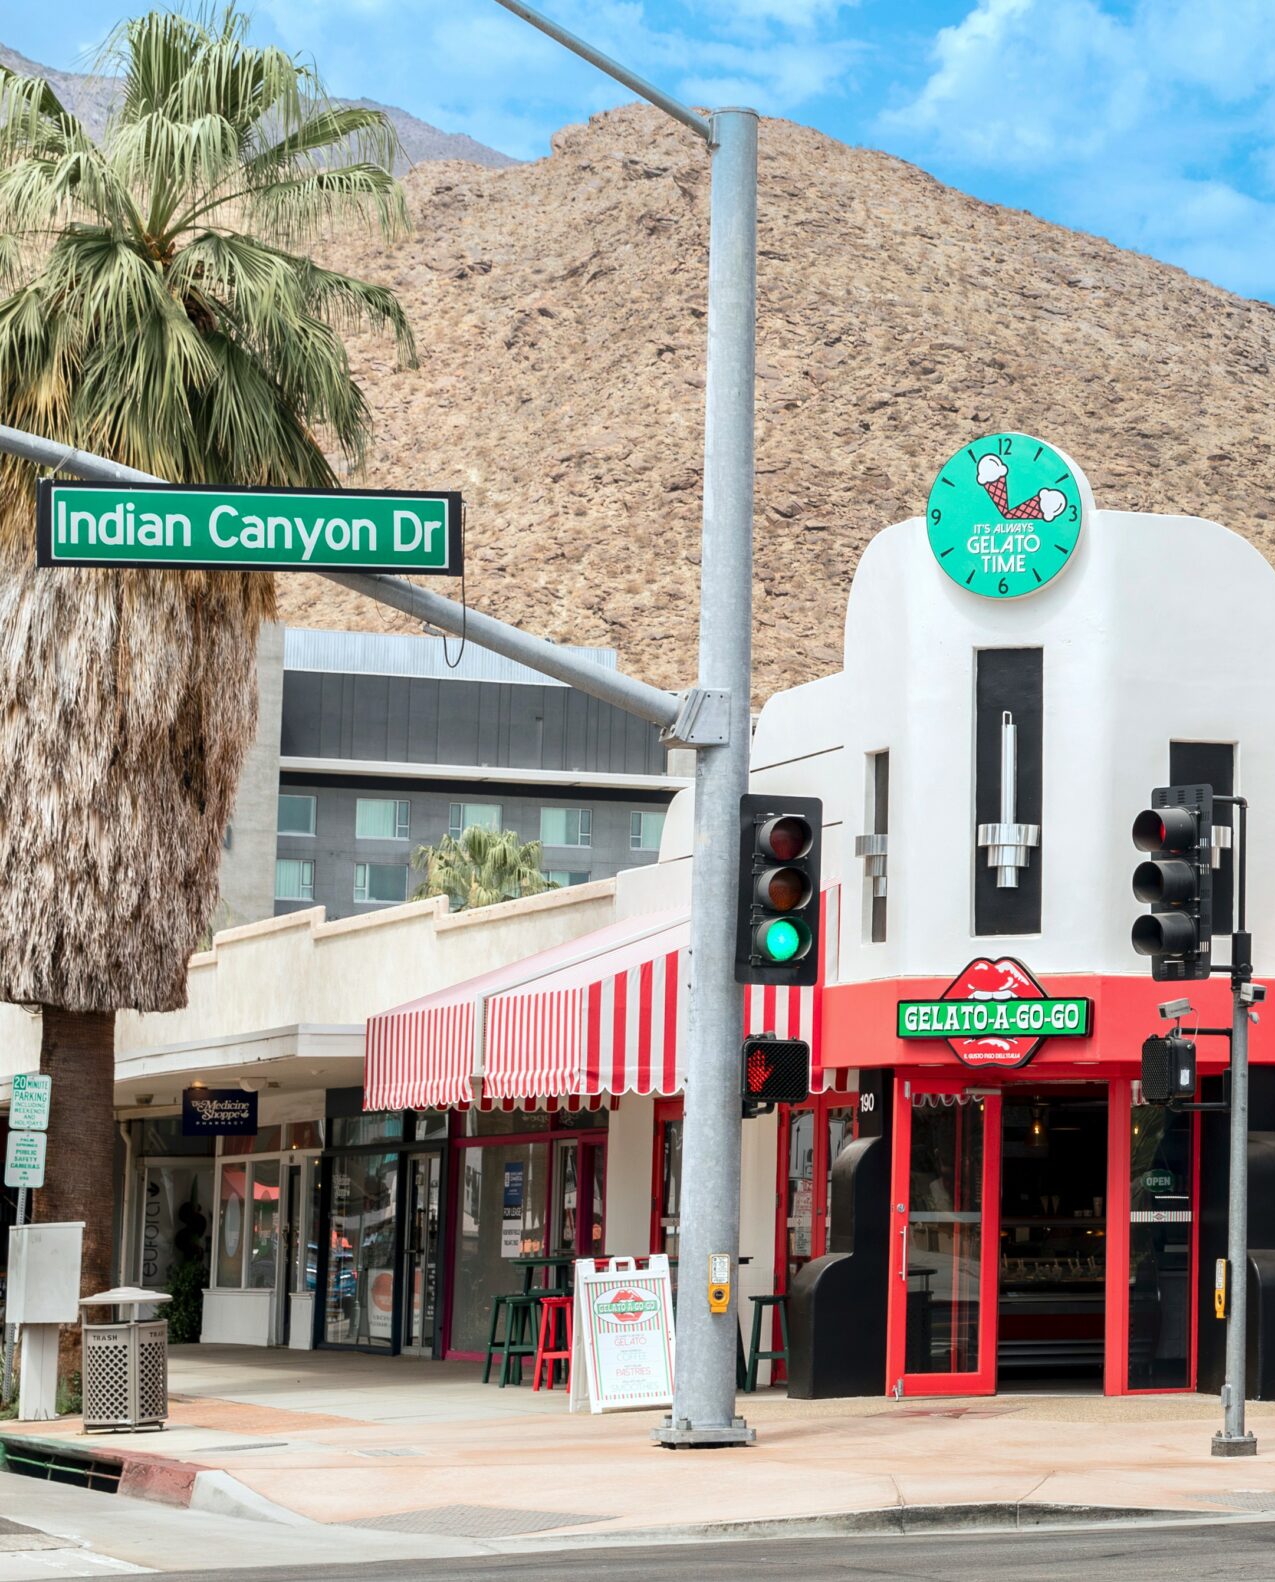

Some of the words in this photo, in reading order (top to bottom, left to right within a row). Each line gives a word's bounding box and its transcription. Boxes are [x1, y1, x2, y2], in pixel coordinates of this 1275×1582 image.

[998, 438, 1013, 456] 12
[931, 508, 942, 526] 9
[1068, 504, 1078, 523] 3
[57, 500, 192, 547] Indian
[208, 504, 377, 560] Canyon
[393, 510, 442, 552] Dr
[973, 523, 991, 534] IT'S
[993, 522, 1035, 534] ALWAYS
[966, 534, 1041, 554] GELATO
[981, 554, 1026, 573] TIME
[998, 577, 1009, 594] 6
[904, 1003, 1079, 1032] GELATO-A-GO-GO
[14, 1076, 26, 1089] 20
[27, 1080, 49, 1089] MINUTE
[15, 1091, 48, 1102] PARKING
[860, 1093, 875, 1112] 190
[197, 1100, 250, 1111] Medicine
[202, 1109, 241, 1120] Shoppe
[1146, 1176, 1171, 1186] OPEN
[598, 1301, 625, 1313] GELATO
[614, 1337, 648, 1346] GELATO
